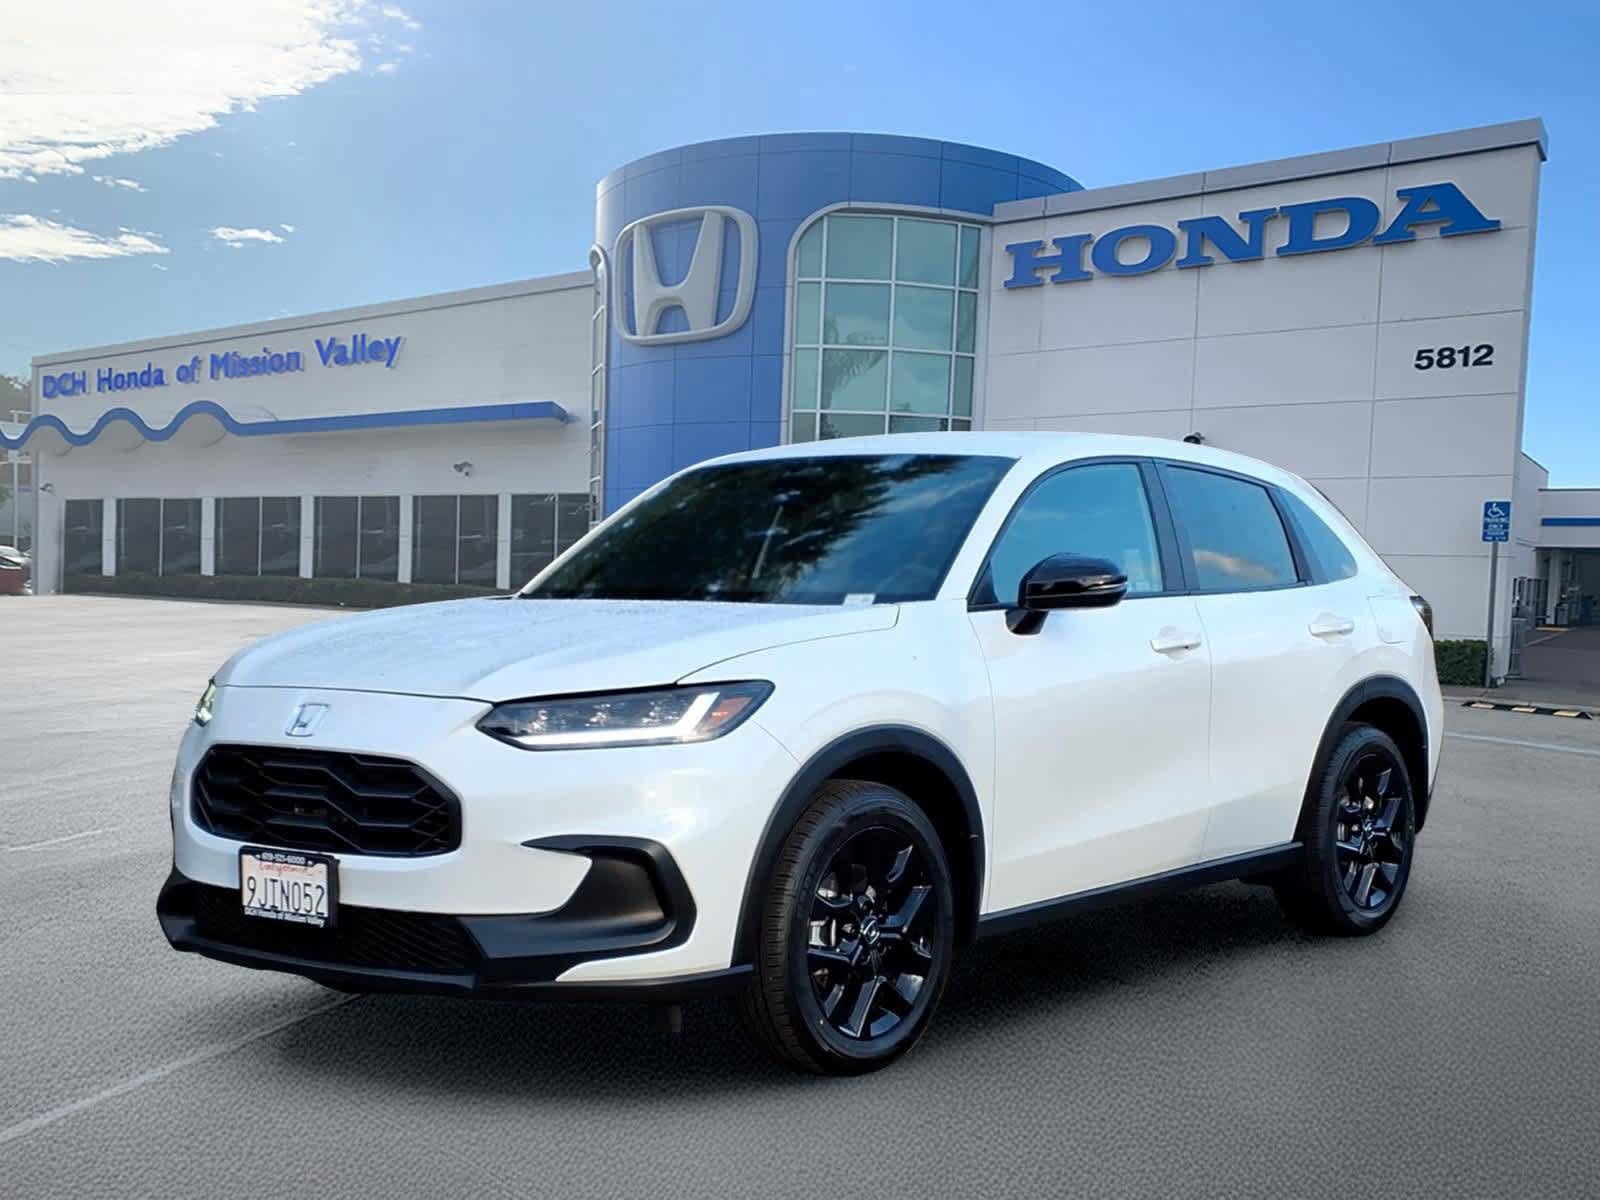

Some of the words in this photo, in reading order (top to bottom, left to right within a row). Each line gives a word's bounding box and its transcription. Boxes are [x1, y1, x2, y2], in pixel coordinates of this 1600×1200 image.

[1004, 181, 1501, 289] HONDA
[43, 370, 87, 399] DCH
[97, 362, 164, 391] Honda
[176, 355, 200, 384] of
[210, 347, 302, 380] Mission
[315, 333, 402, 368] Valley
[1415, 344, 1494, 370] 5812
